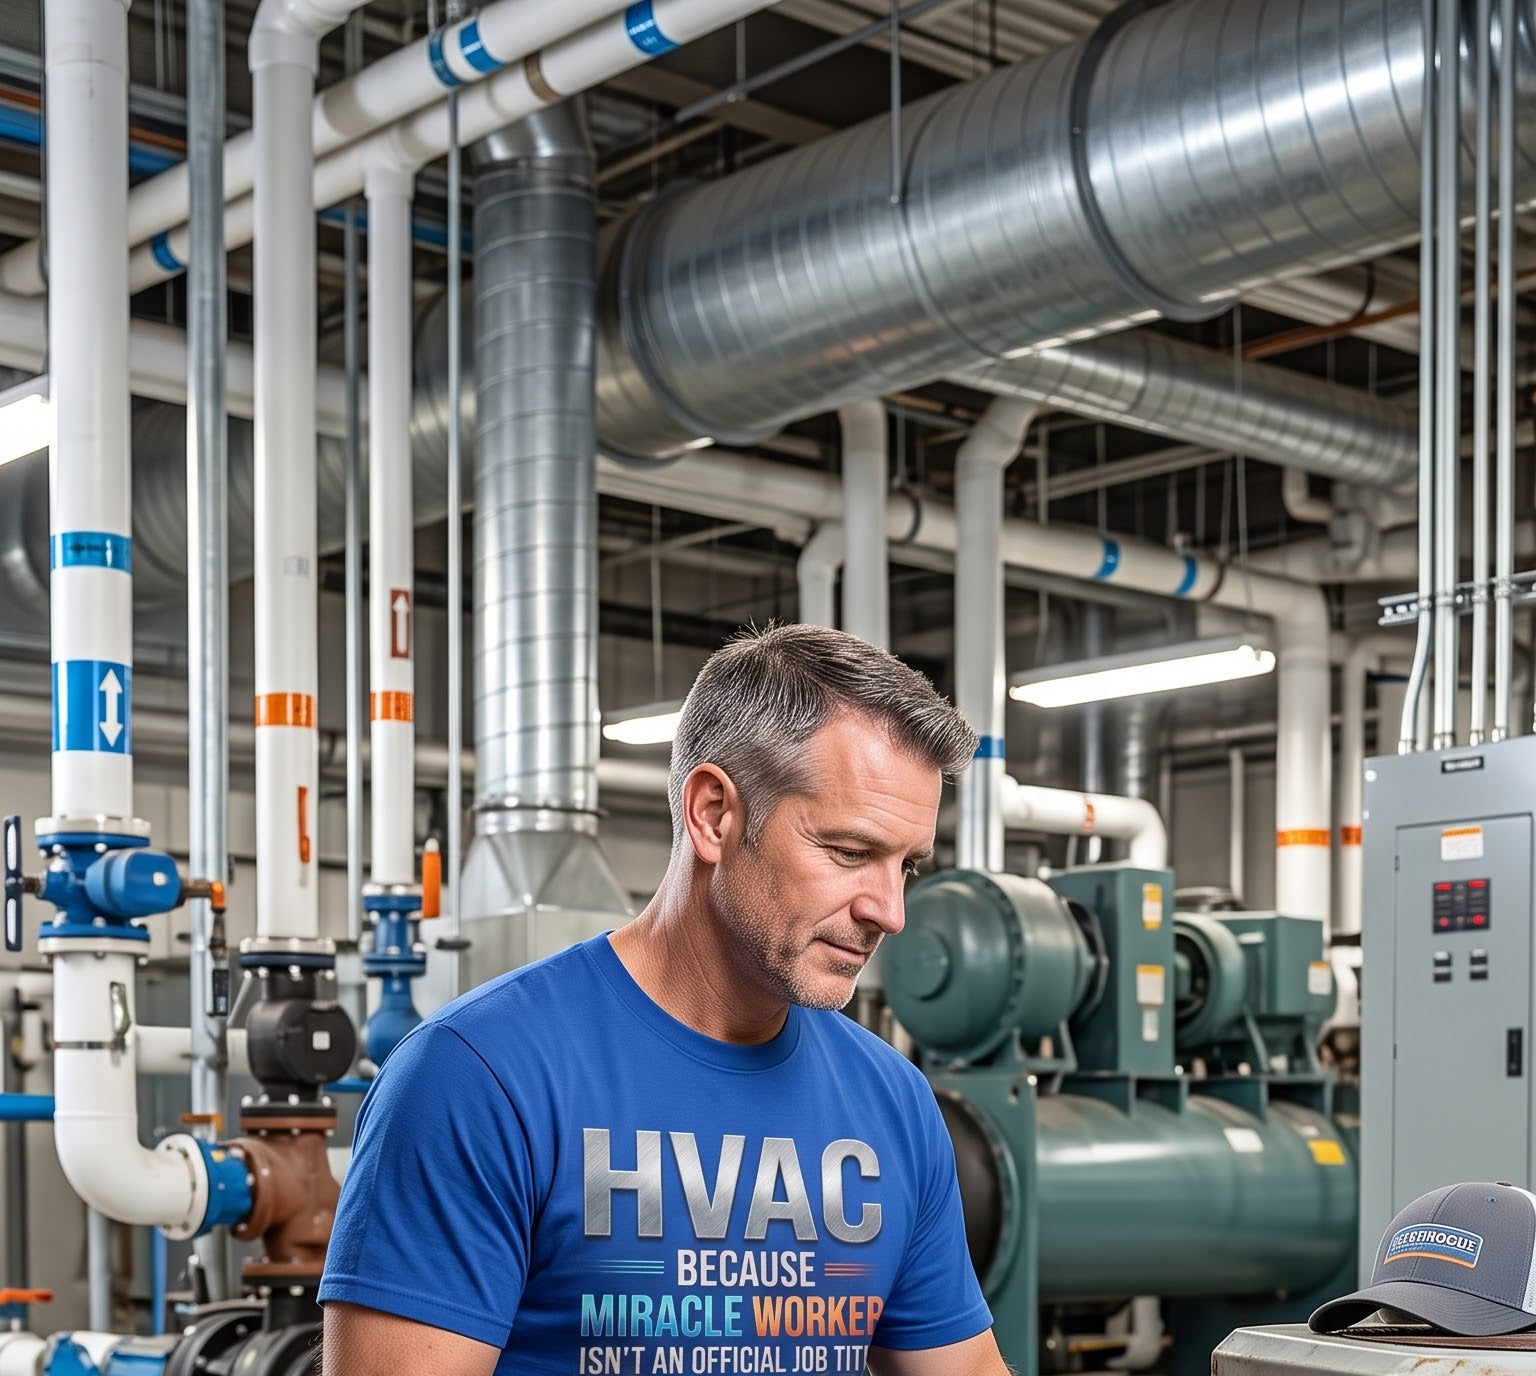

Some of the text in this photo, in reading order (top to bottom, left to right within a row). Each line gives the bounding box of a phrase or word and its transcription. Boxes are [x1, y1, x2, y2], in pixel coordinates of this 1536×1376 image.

[582, 1127, 883, 1244] HVAC
[676, 1249, 816, 1288] BECAUSE
[579, 1293, 743, 1338] MIRACLE
[579, 1346, 646, 1375] ISN'T
[652, 1346, 684, 1375] AN
[692, 1345, 787, 1374] OFFICIAL
[792, 1345, 828, 1374] JOB
